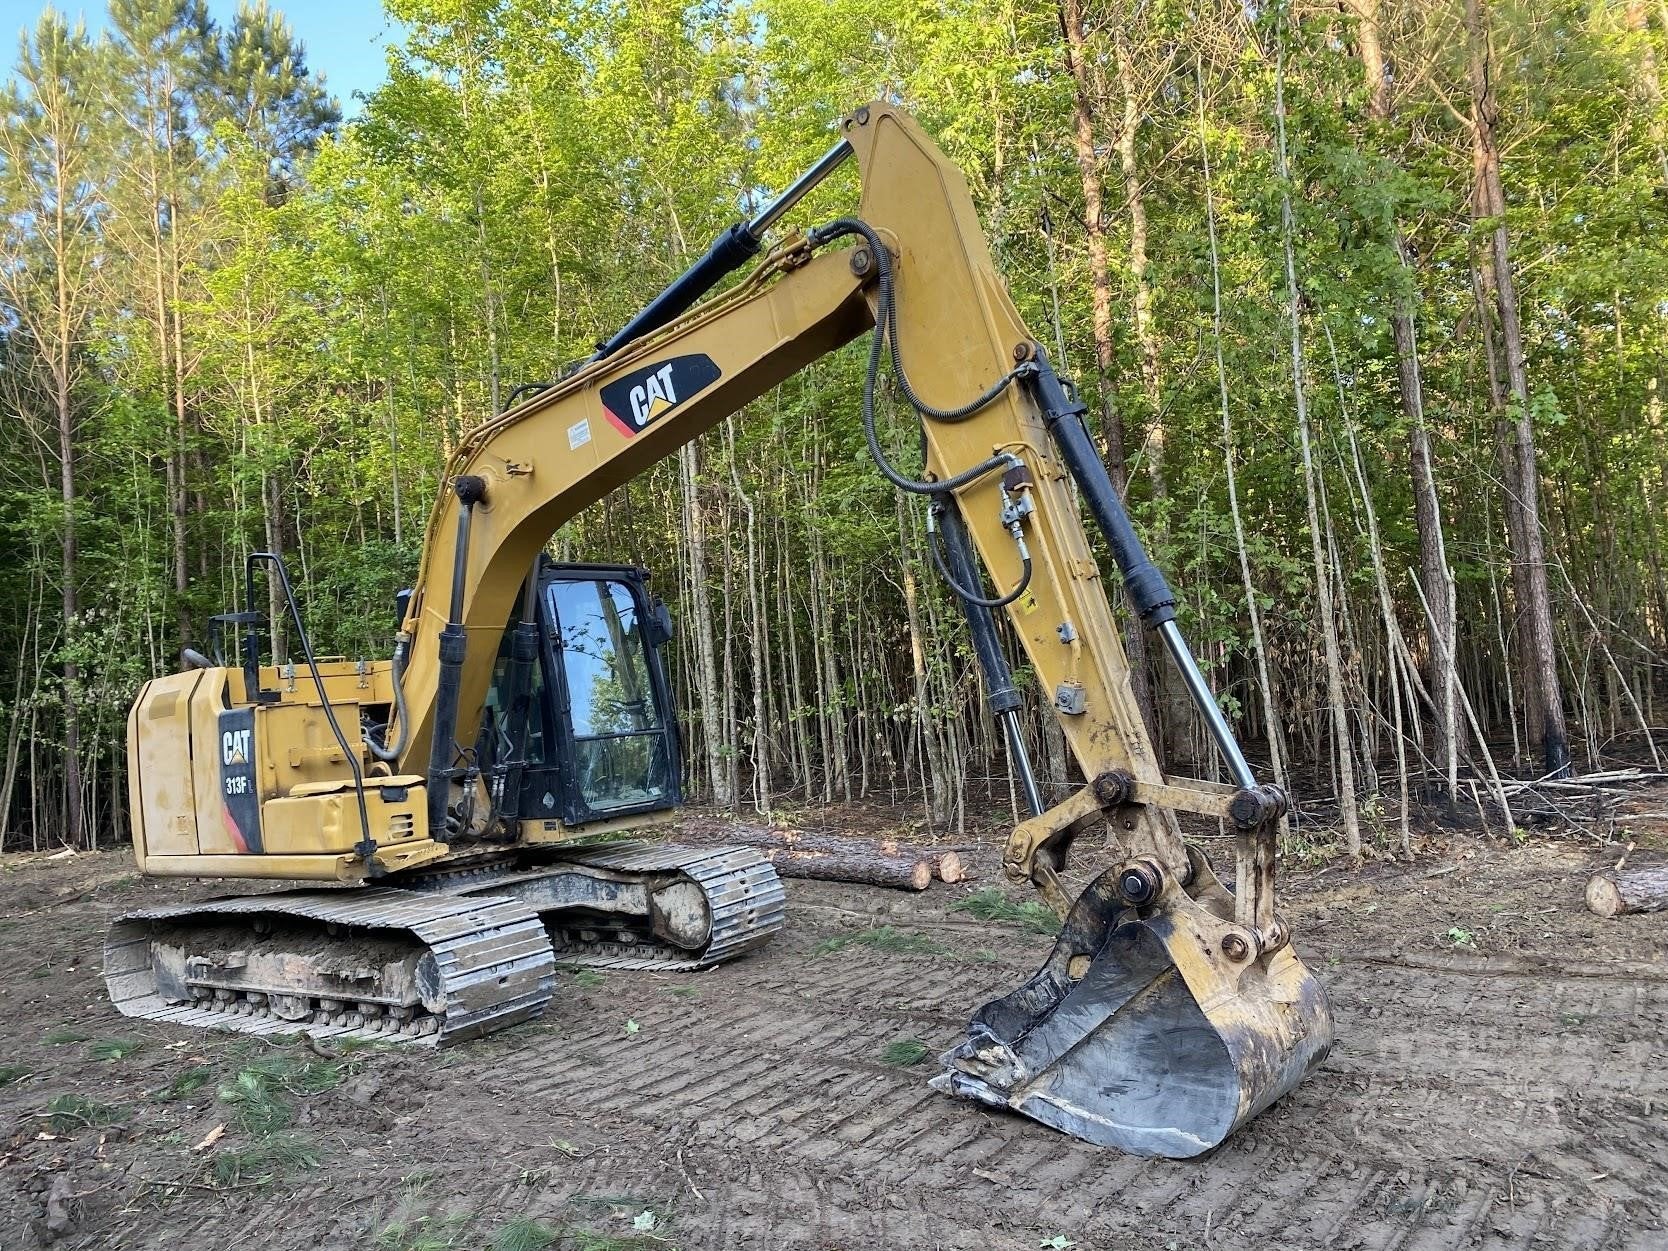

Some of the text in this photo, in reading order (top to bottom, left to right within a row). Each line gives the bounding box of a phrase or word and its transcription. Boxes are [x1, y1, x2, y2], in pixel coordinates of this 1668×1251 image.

[629, 363, 677, 425] CAT
[222, 730, 250, 766] CAT
[226, 776, 247, 795] 313F
